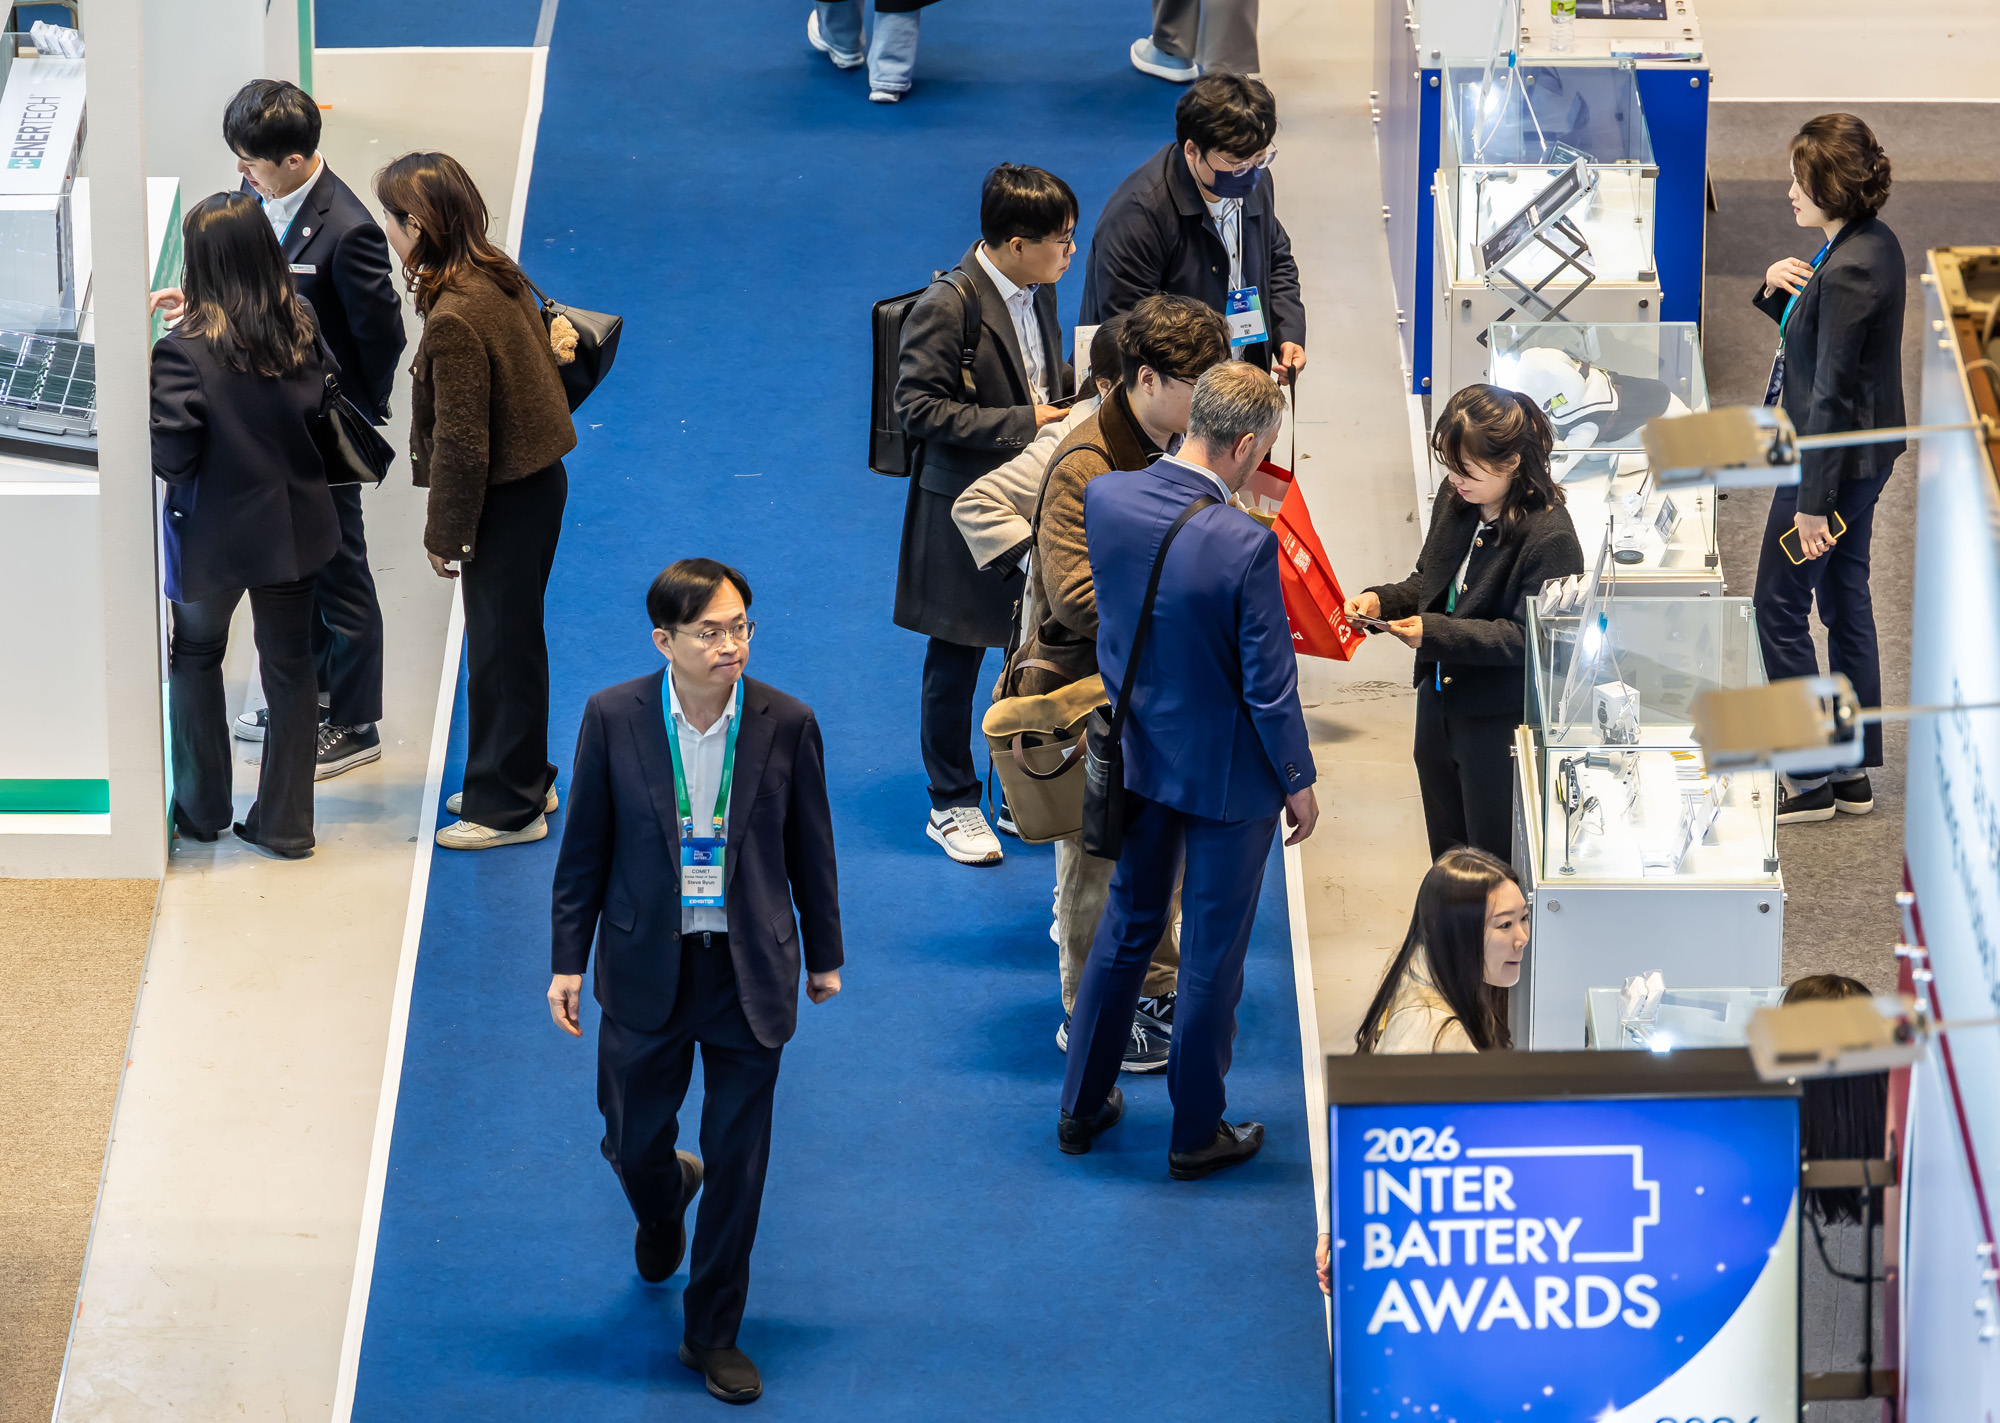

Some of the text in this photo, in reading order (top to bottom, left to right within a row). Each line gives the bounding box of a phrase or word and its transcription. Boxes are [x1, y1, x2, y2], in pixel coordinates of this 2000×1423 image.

[10, 96, 61, 158] ENERTECH
[1363, 1126, 1461, 1162] 2026
[1363, 1165, 1516, 1215] INTER
[1363, 1217, 1583, 1269] BATTERY
[1366, 1273, 1661, 1335] AWARDS
